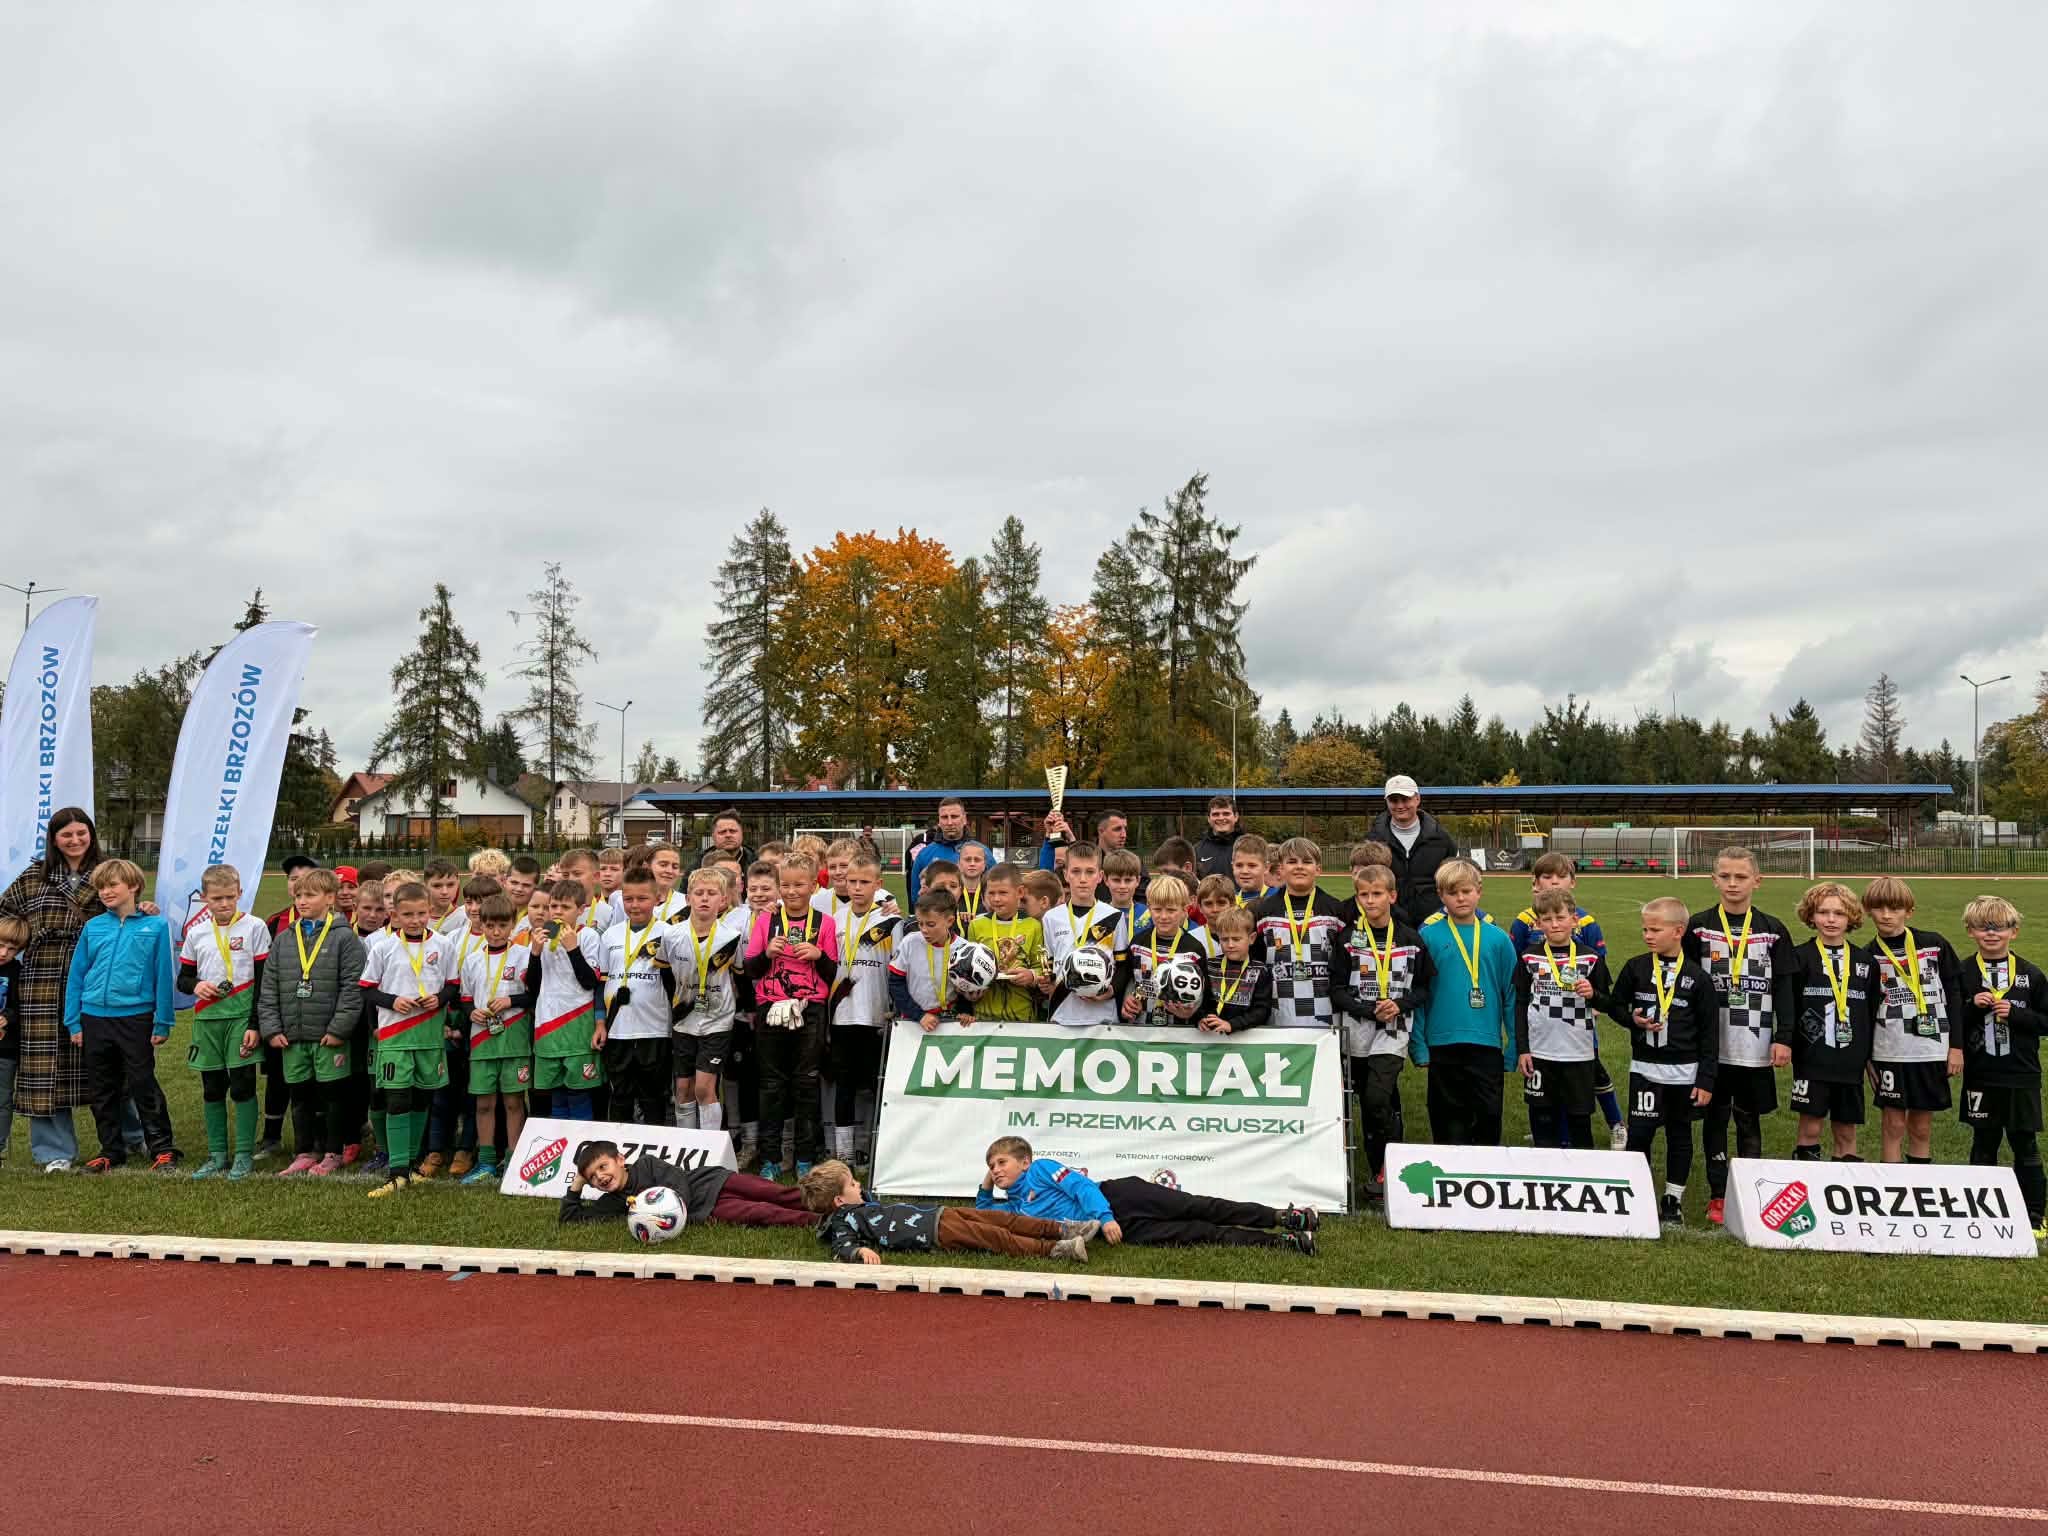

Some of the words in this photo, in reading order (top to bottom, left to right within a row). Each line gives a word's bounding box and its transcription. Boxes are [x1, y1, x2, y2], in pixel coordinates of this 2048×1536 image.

[37, 646, 59, 767] BRZOZÓW
[208, 789, 237, 865] RZEŁKI
[223, 663, 262, 783] BRZOZÓW
[35, 773, 52, 860] RZEŁKI
[382, 1062, 396, 1082] 10
[920, 1045, 1302, 1098] MEMORIAŁ
[1637, 1091, 1655, 1112] 10
[1007, 1111, 1040, 1127] IM.
[1048, 1112, 1177, 1132] PRZEMKA
[1186, 1118, 1304, 1135] GRUSZKI
[522, 1141, 563, 1178] ORZEŁKI
[1032, 1150, 1081, 1158] NIZATORZY:
[1115, 1153, 1160, 1161] PATRONAT
[1435, 1180, 1635, 1216] POLIKAT
[1763, 1184, 1806, 1227] ORZEŁKI
[1824, 1184, 2012, 1219] ORZEŁKI
[1831, 1221, 2015, 1240] BRZOZÓW
